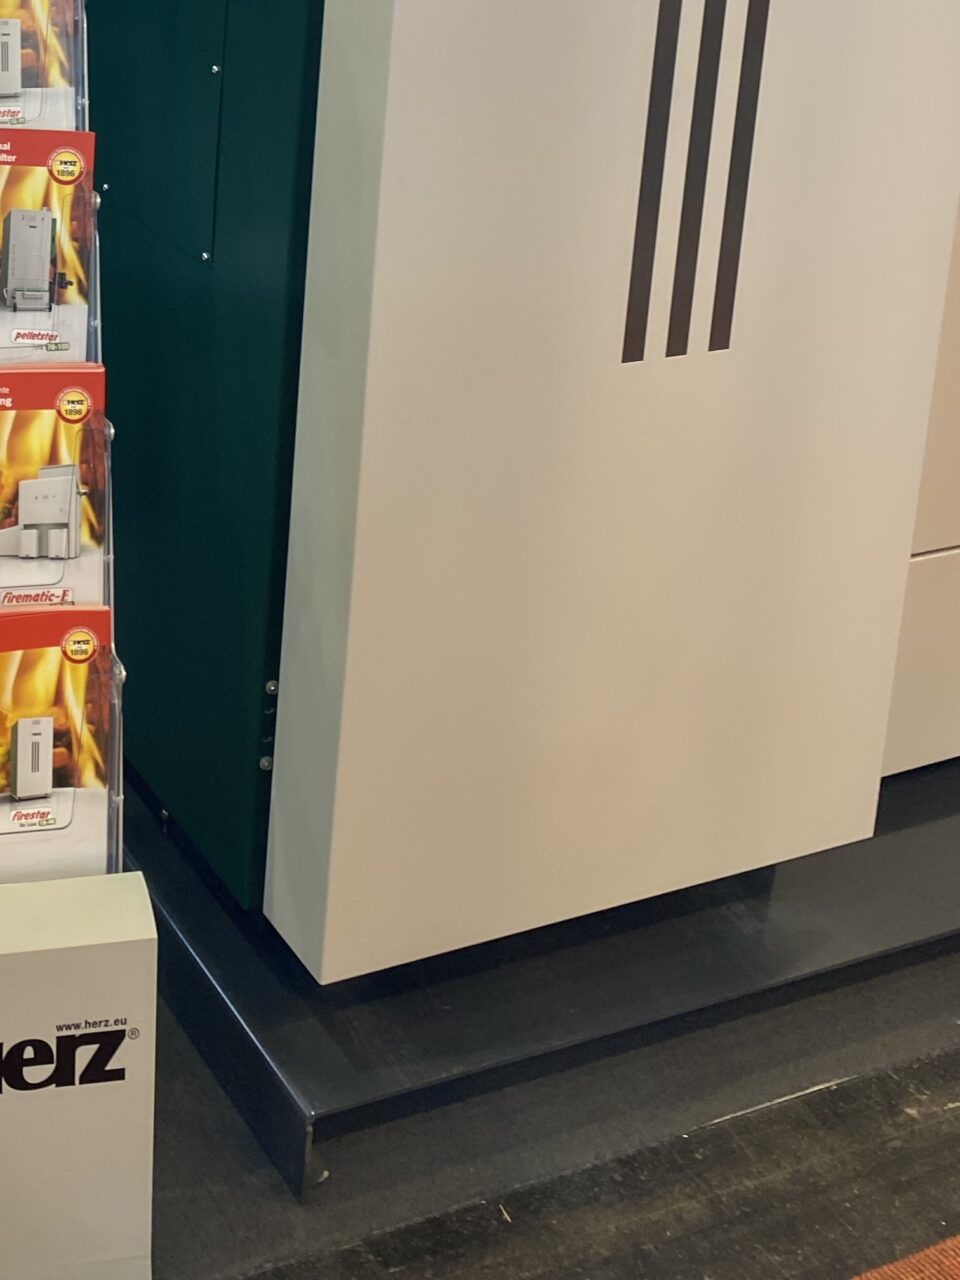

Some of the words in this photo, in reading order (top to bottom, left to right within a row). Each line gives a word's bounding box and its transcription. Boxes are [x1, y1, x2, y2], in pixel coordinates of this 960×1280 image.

[57, 169, 76, 177] 1896
[14, 331, 58, 342] pelletstar
[64, 408, 83, 416] 1896
[70, 648, 89, 656] 1896
[55, 1017, 127, 1033] www.herz.eu
